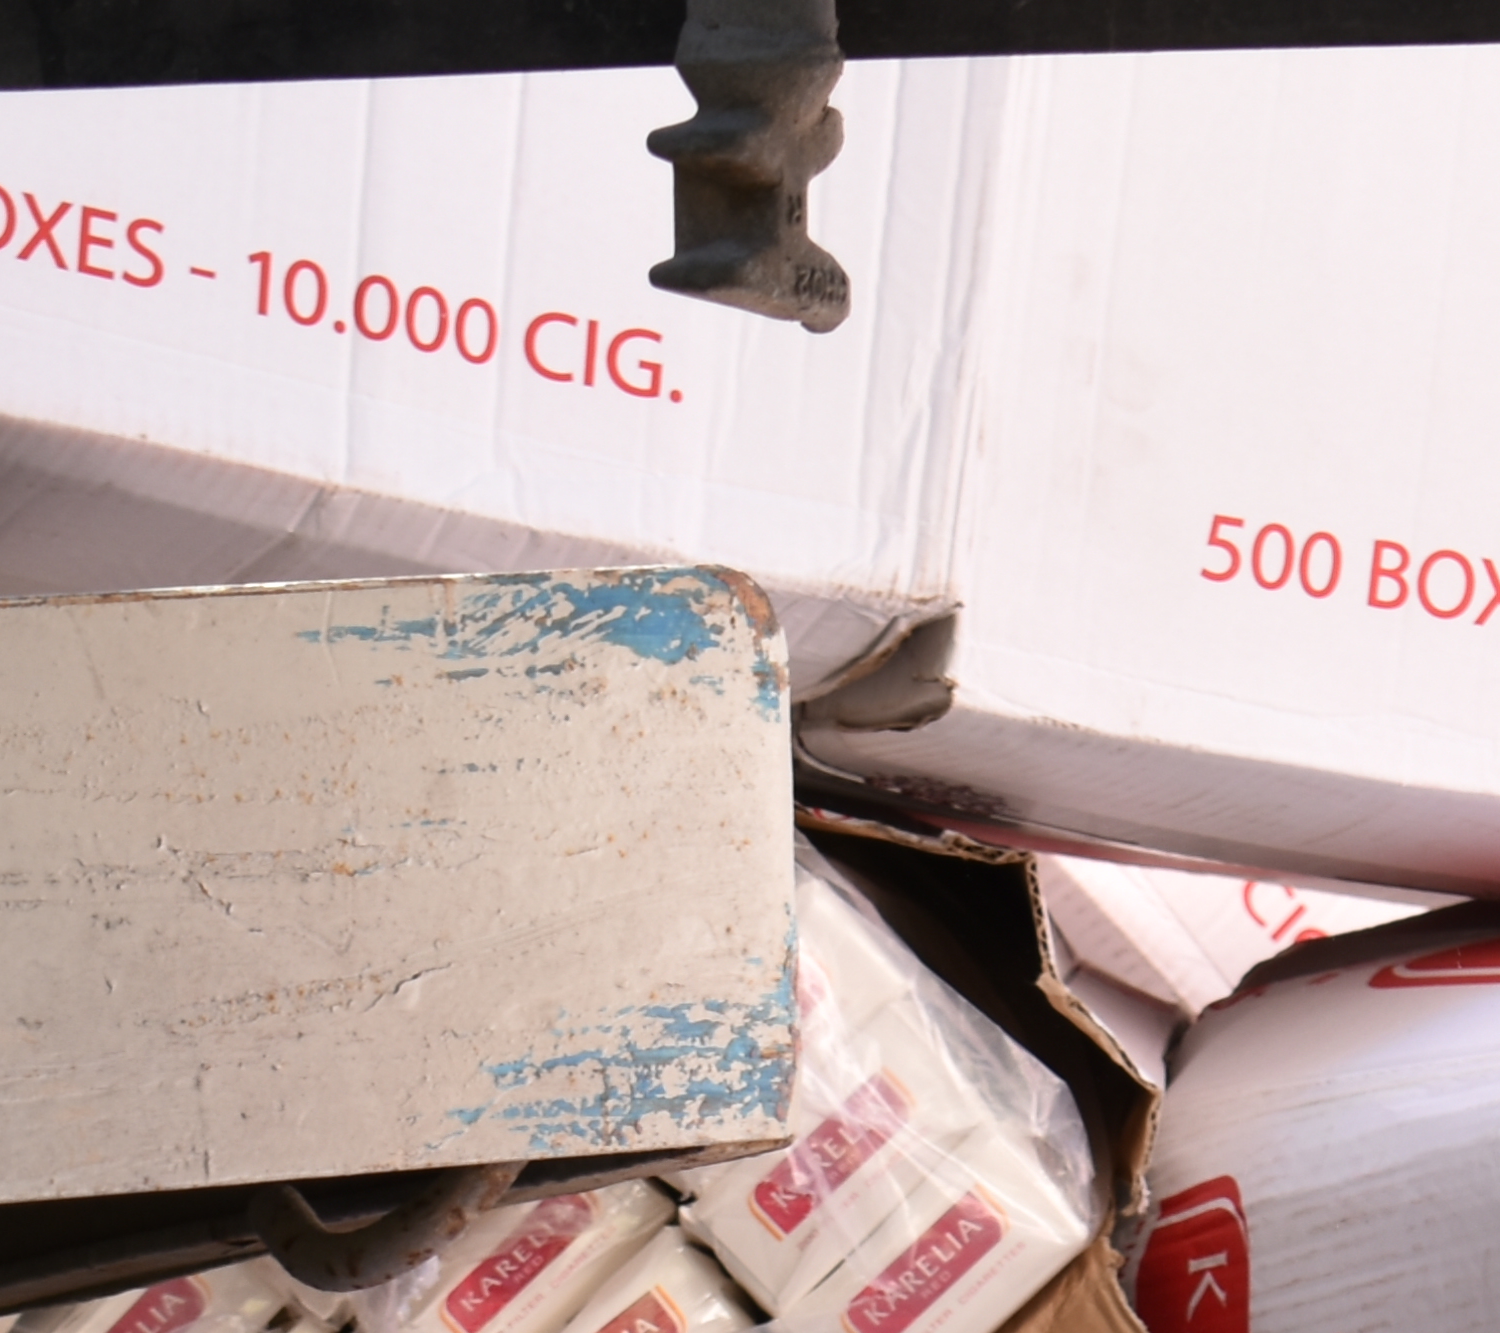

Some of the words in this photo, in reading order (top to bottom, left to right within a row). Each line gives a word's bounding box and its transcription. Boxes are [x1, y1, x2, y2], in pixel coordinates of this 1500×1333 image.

[246, 250, 499, 365] 10.000
[522, 311, 686, 404] CIG.
[1199, 513, 1343, 600] 500
[862, 1217, 983, 1327] KARELIA
